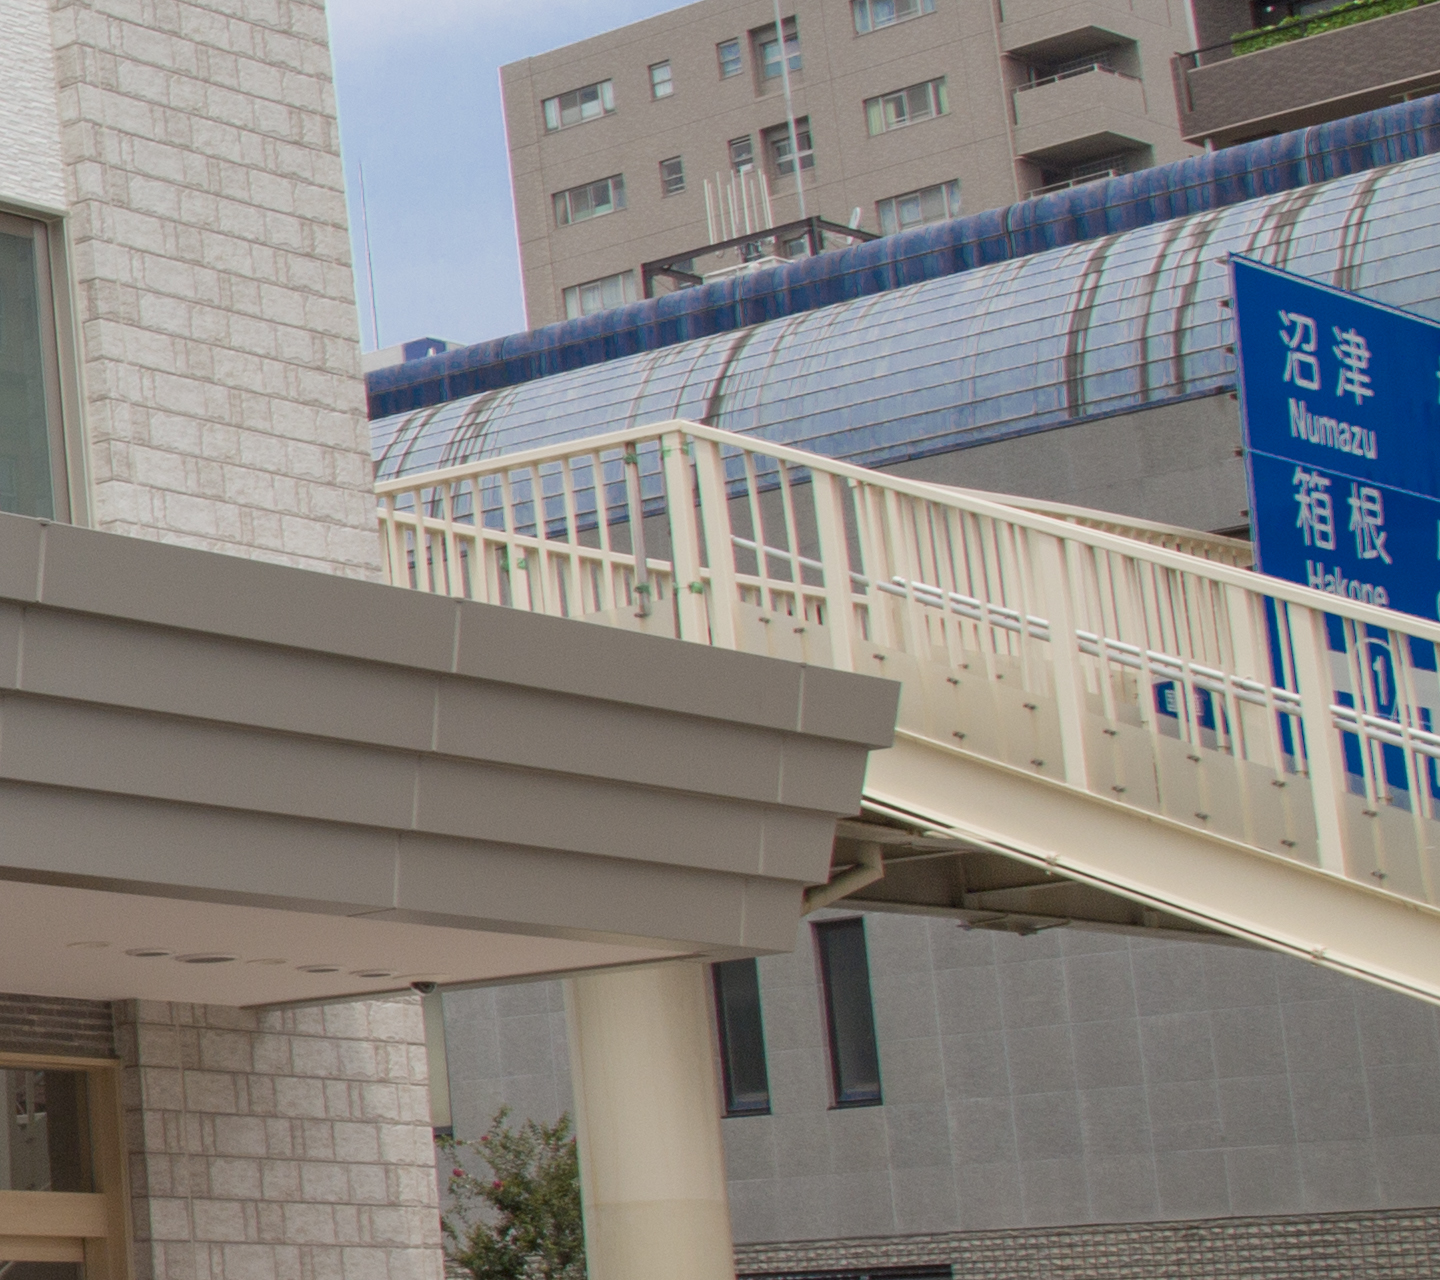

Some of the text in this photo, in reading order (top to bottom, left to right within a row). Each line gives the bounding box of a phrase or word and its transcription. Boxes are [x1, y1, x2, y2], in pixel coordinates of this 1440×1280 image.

[1279, 308, 1374, 406] 沼津
[1288, 397, 1379, 461] Numazu
[1292, 467, 1392, 565] 箱根
